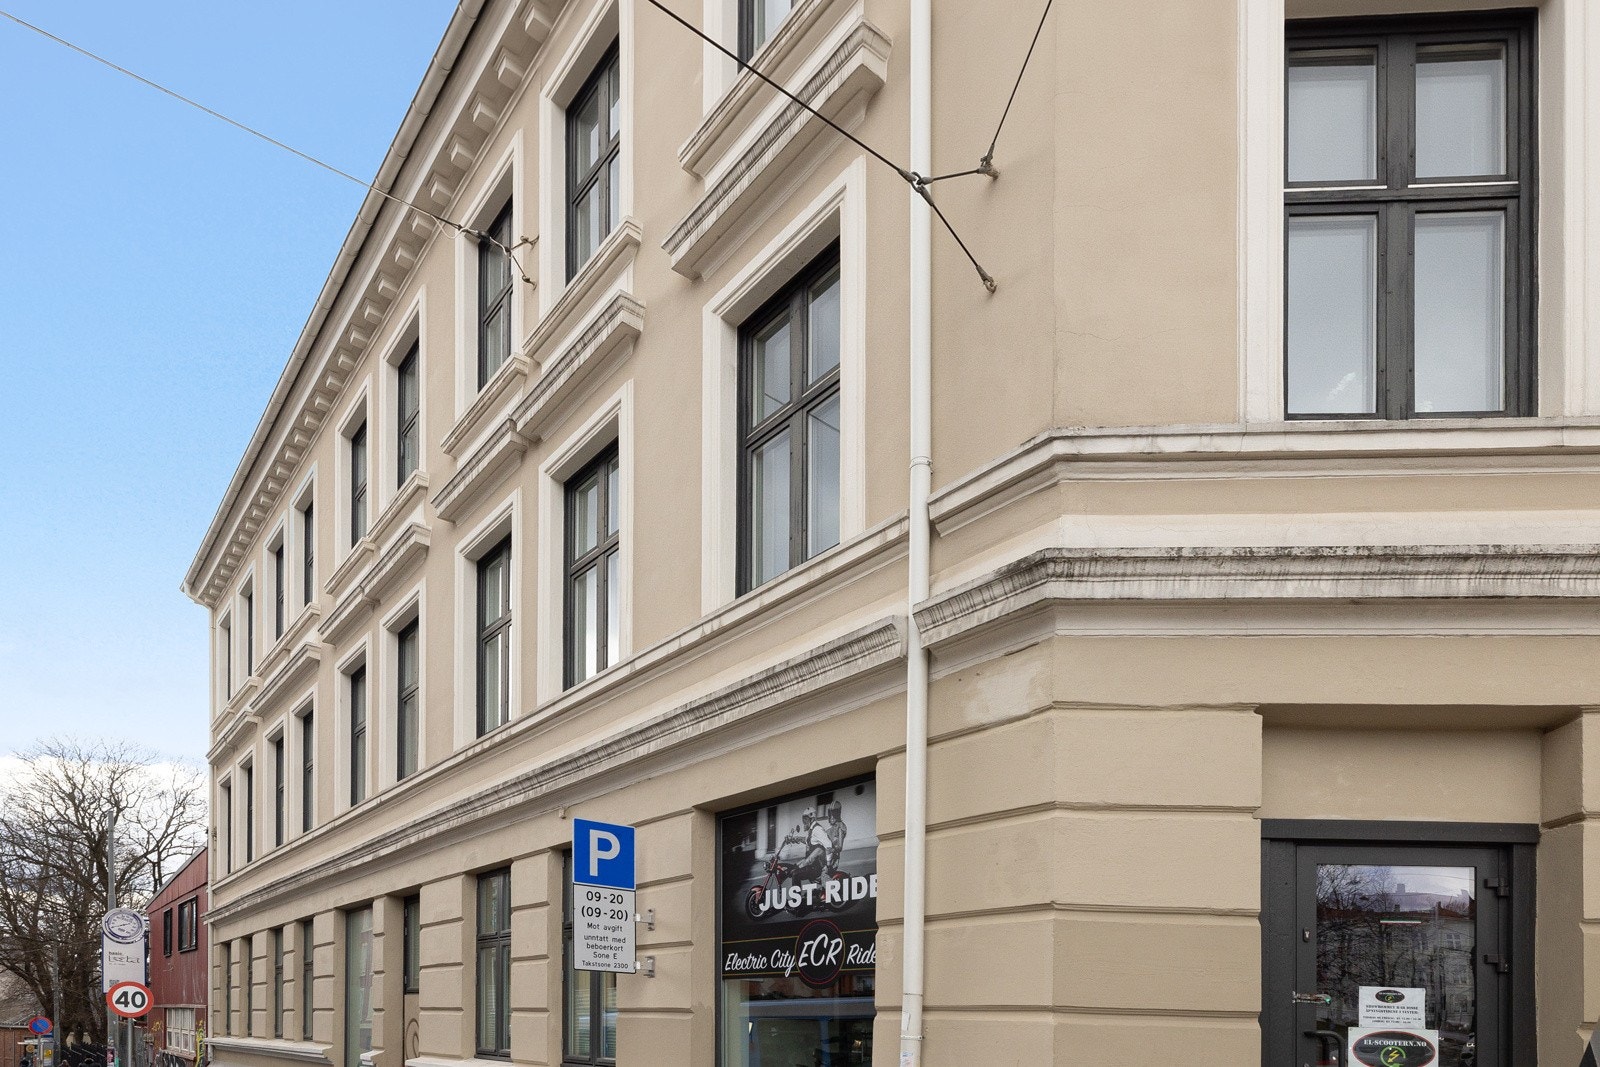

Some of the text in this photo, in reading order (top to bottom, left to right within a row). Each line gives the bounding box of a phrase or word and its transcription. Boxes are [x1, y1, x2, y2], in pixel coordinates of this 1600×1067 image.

[589, 829, 621, 877] P
[759, 883, 818, 912] JUST
[587, 922, 623, 933] Mot avgift
[583, 934, 609, 942] unntatt
[586, 942, 624, 952] beboerkort
[798, 933, 843, 968] ECR
[593, 951, 618, 960] Sone E
[724, 952, 768, 971] Electric
[770, 949, 797, 977] City
[582, 960, 611, 968] Takstsone
[115, 990, 146, 1009] 40
